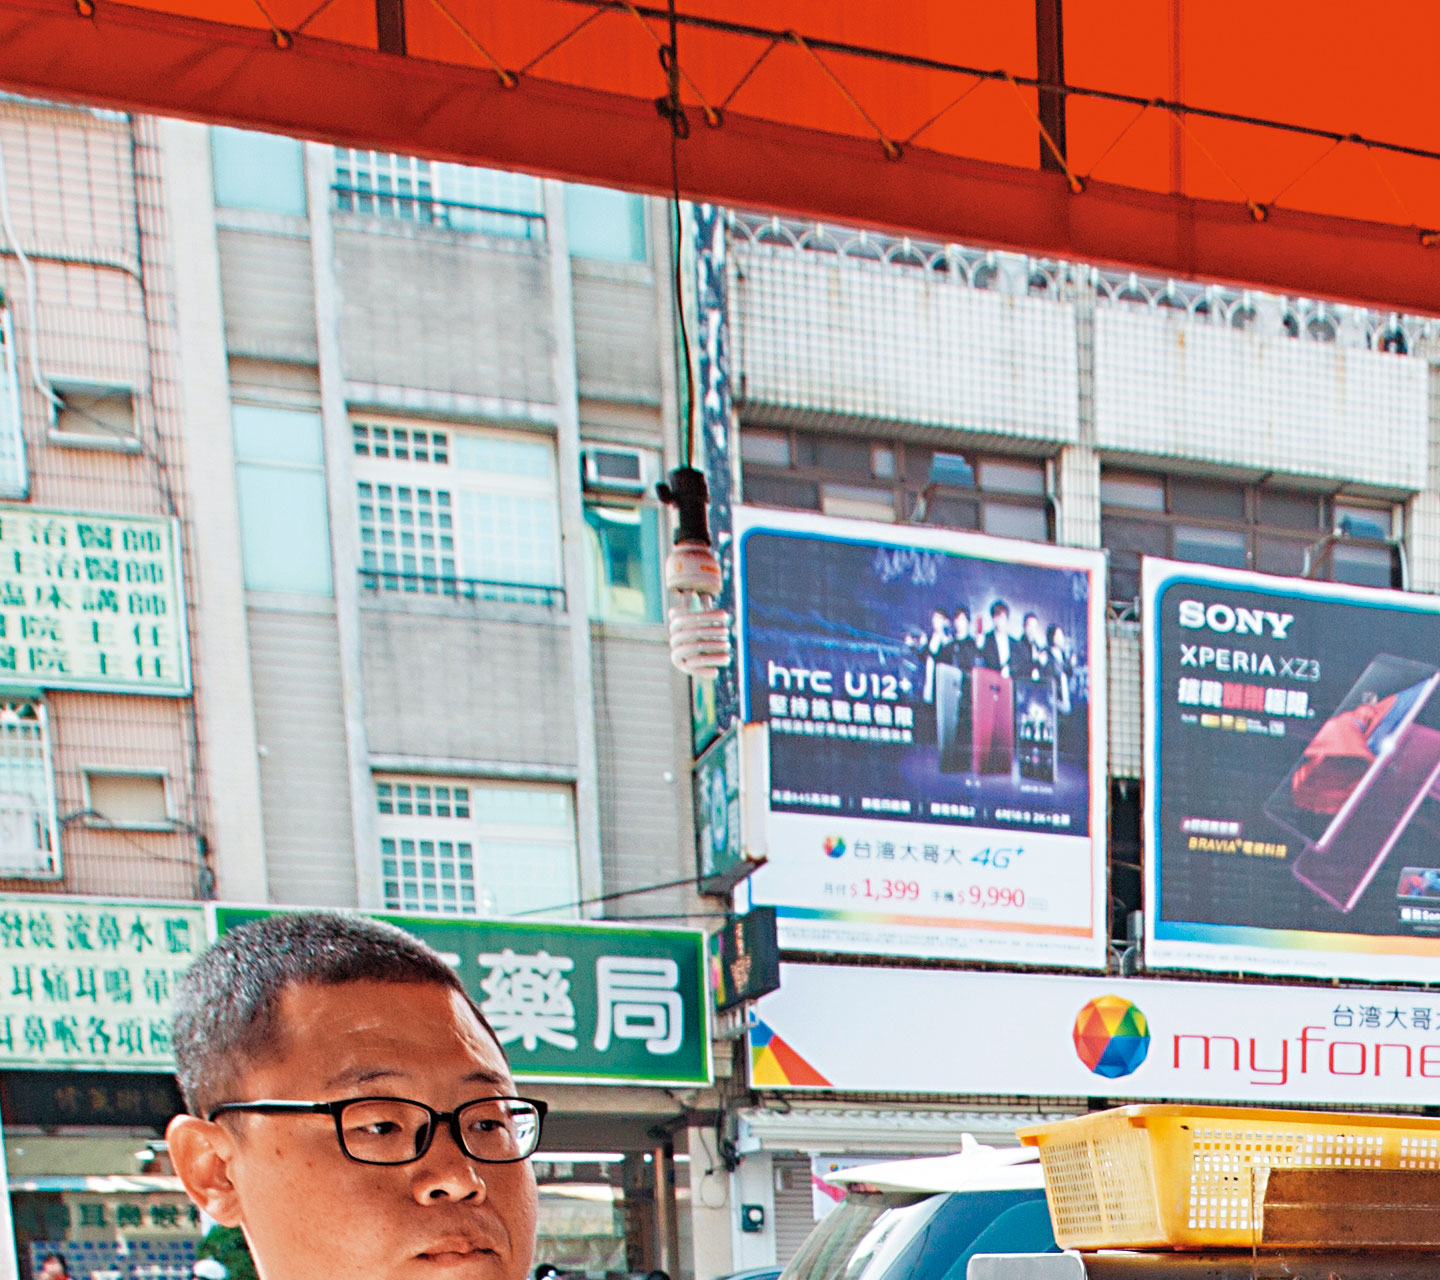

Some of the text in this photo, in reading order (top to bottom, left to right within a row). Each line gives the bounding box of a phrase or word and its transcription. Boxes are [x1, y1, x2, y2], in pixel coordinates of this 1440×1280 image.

[1178, 600, 1295, 641] SONY
[1180, 643, 1321, 682] XPERIA XZ3
[448, 949, 684, 1054] 藥局
